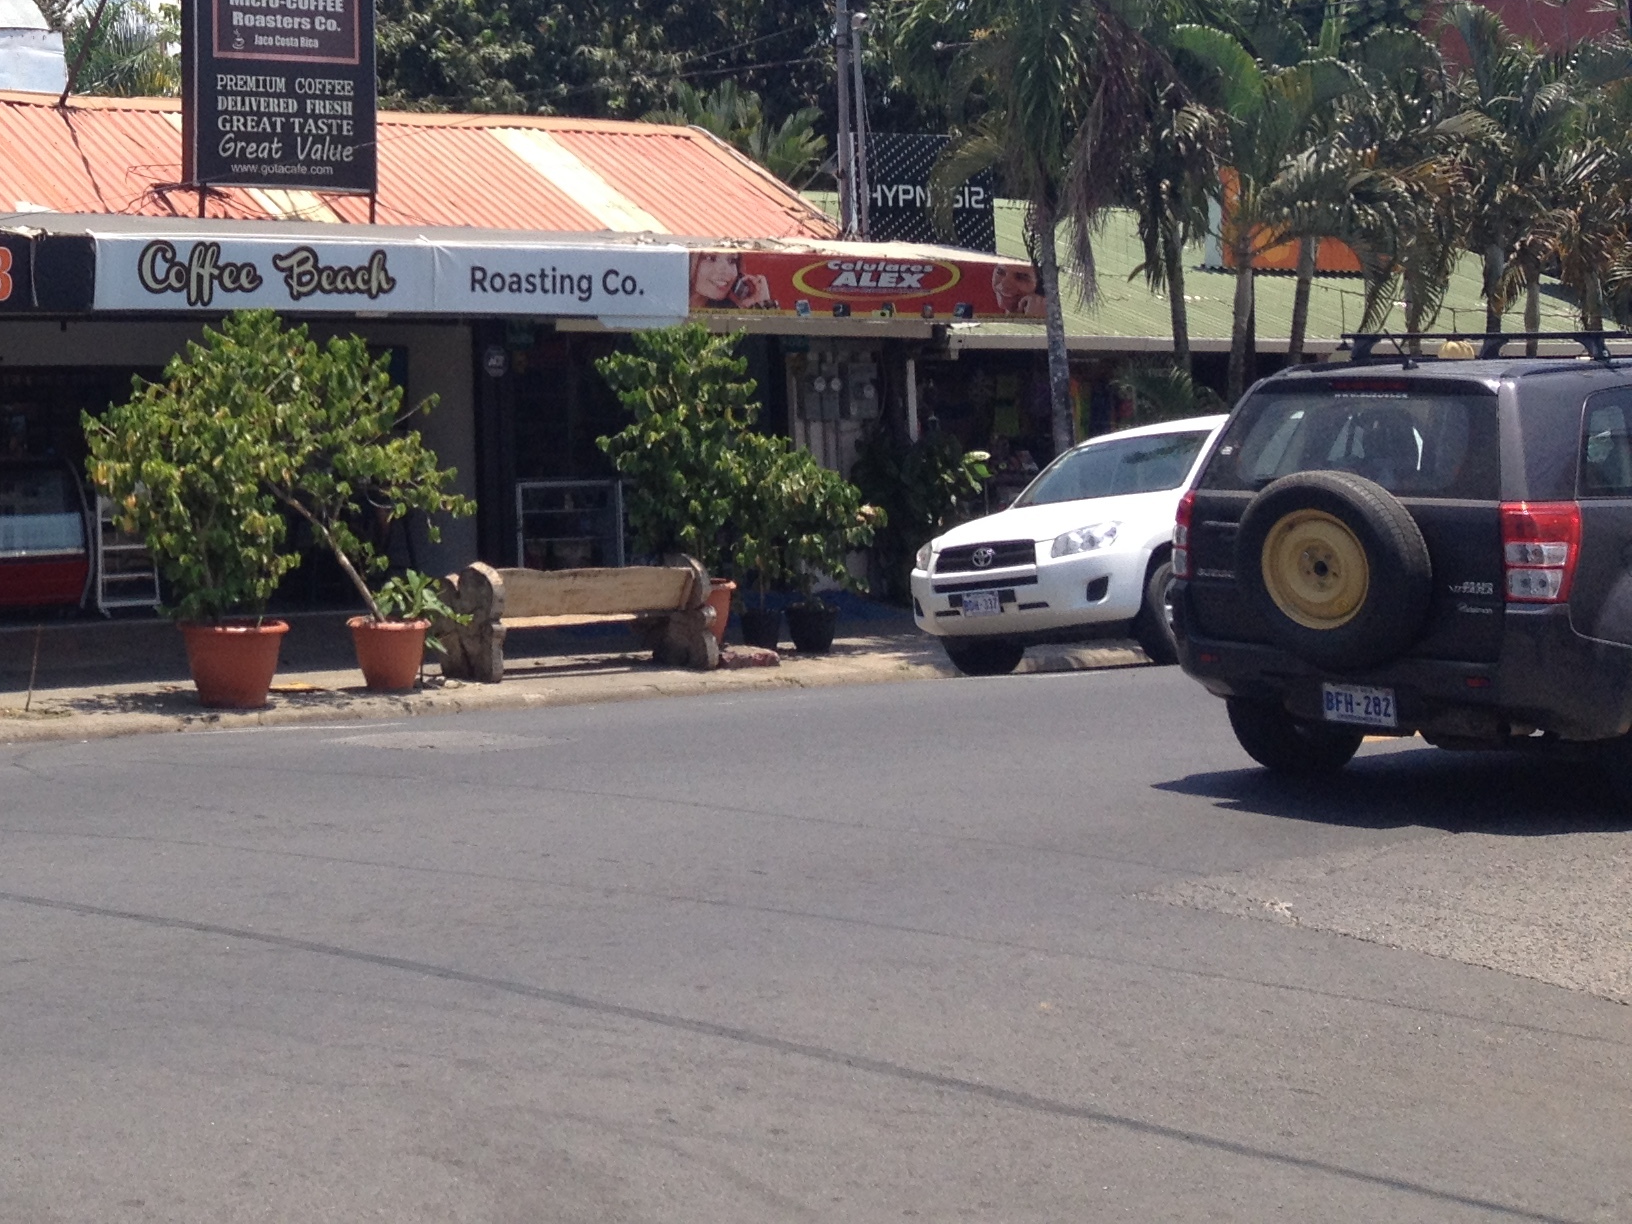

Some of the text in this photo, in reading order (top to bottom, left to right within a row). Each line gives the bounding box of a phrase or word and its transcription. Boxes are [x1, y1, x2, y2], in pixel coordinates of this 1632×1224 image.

[232, 11, 341, 32] Roasters Co.
[254, 35, 319, 48] Jaco Costa Rica
[216, 74, 354, 96] PREMIUM COFFEE
[217, 96, 353, 115] DELIVERED FRESH
[217, 115, 354, 136] GREAT TASTE
[218, 133, 354, 162] Great Value
[137, 239, 396, 307] Coffee Beach
[827, 259, 934, 273] Celulares
[469, 265, 645, 302] Roasting Co.
[832, 272, 925, 288] ALEX
[1326, 690, 1391, 717] BFH-282
